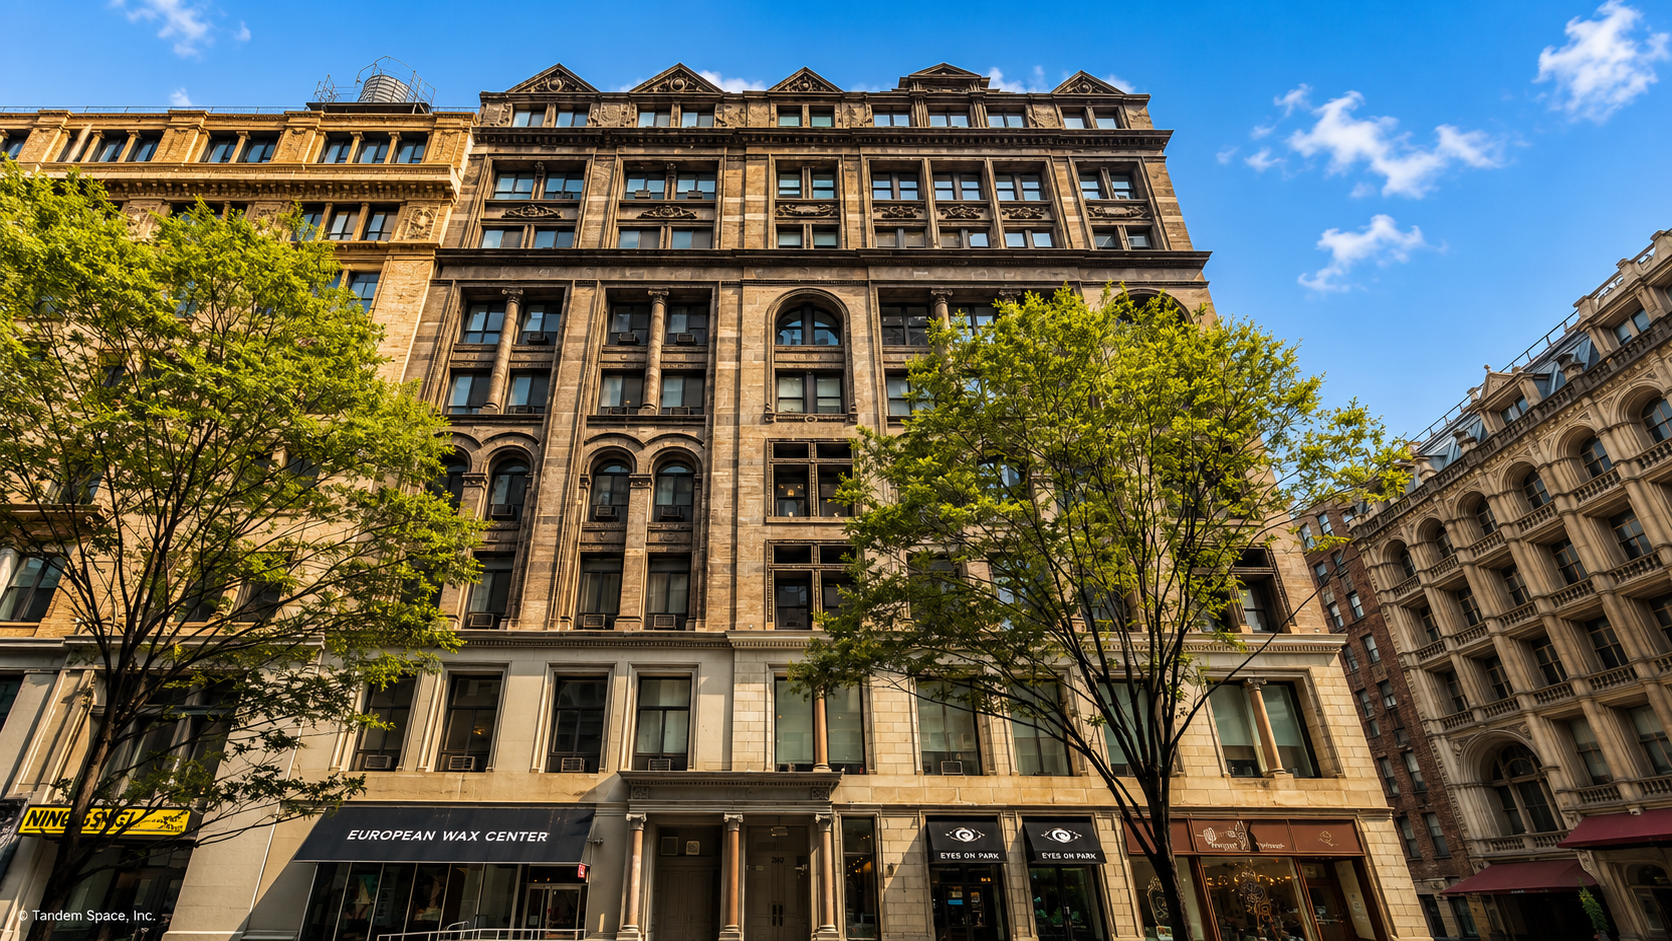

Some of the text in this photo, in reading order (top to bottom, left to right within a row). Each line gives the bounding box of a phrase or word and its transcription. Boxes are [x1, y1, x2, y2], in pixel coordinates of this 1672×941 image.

[346, 829, 548, 842] EUROPEAN WAX CENTER
[940, 852, 1000, 860] EYES ON PARK
[1041, 852, 1097, 860] EYES ON PARK
